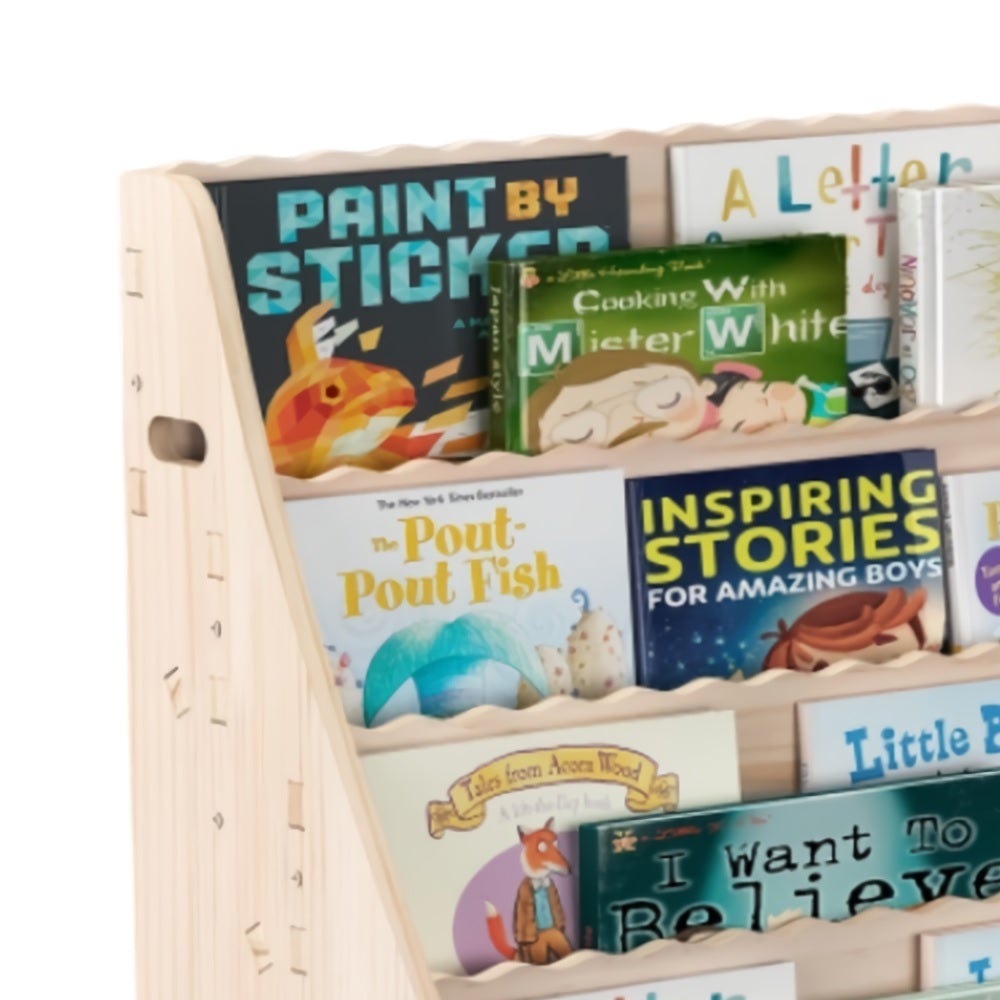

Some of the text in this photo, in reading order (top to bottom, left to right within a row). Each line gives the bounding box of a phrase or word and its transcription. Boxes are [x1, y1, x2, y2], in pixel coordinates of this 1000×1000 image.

[276, 176, 579, 243] PAINT BY
[721, 142, 973, 222] A Letter
[572, 275, 787, 316] Cooking With
[527, 326, 695, 366] Mister
[705, 307, 847, 350] White
[642, 469, 937, 535] INSPIRING
[372, 507, 526, 564] The Pout-
[645, 507, 942, 585] STORIES
[338, 550, 562, 618] Pout Fish
[648, 557, 943, 612] FOR AMAZING BOYS
[458, 777, 500, 800] Tales
[504, 762, 543, 784] from
[597, 750, 643, 782] Wood
[844, 726, 970, 784] Little
[656, 850, 690, 891] I
[724, 825, 872, 879] Want
[906, 816, 974, 855] To
